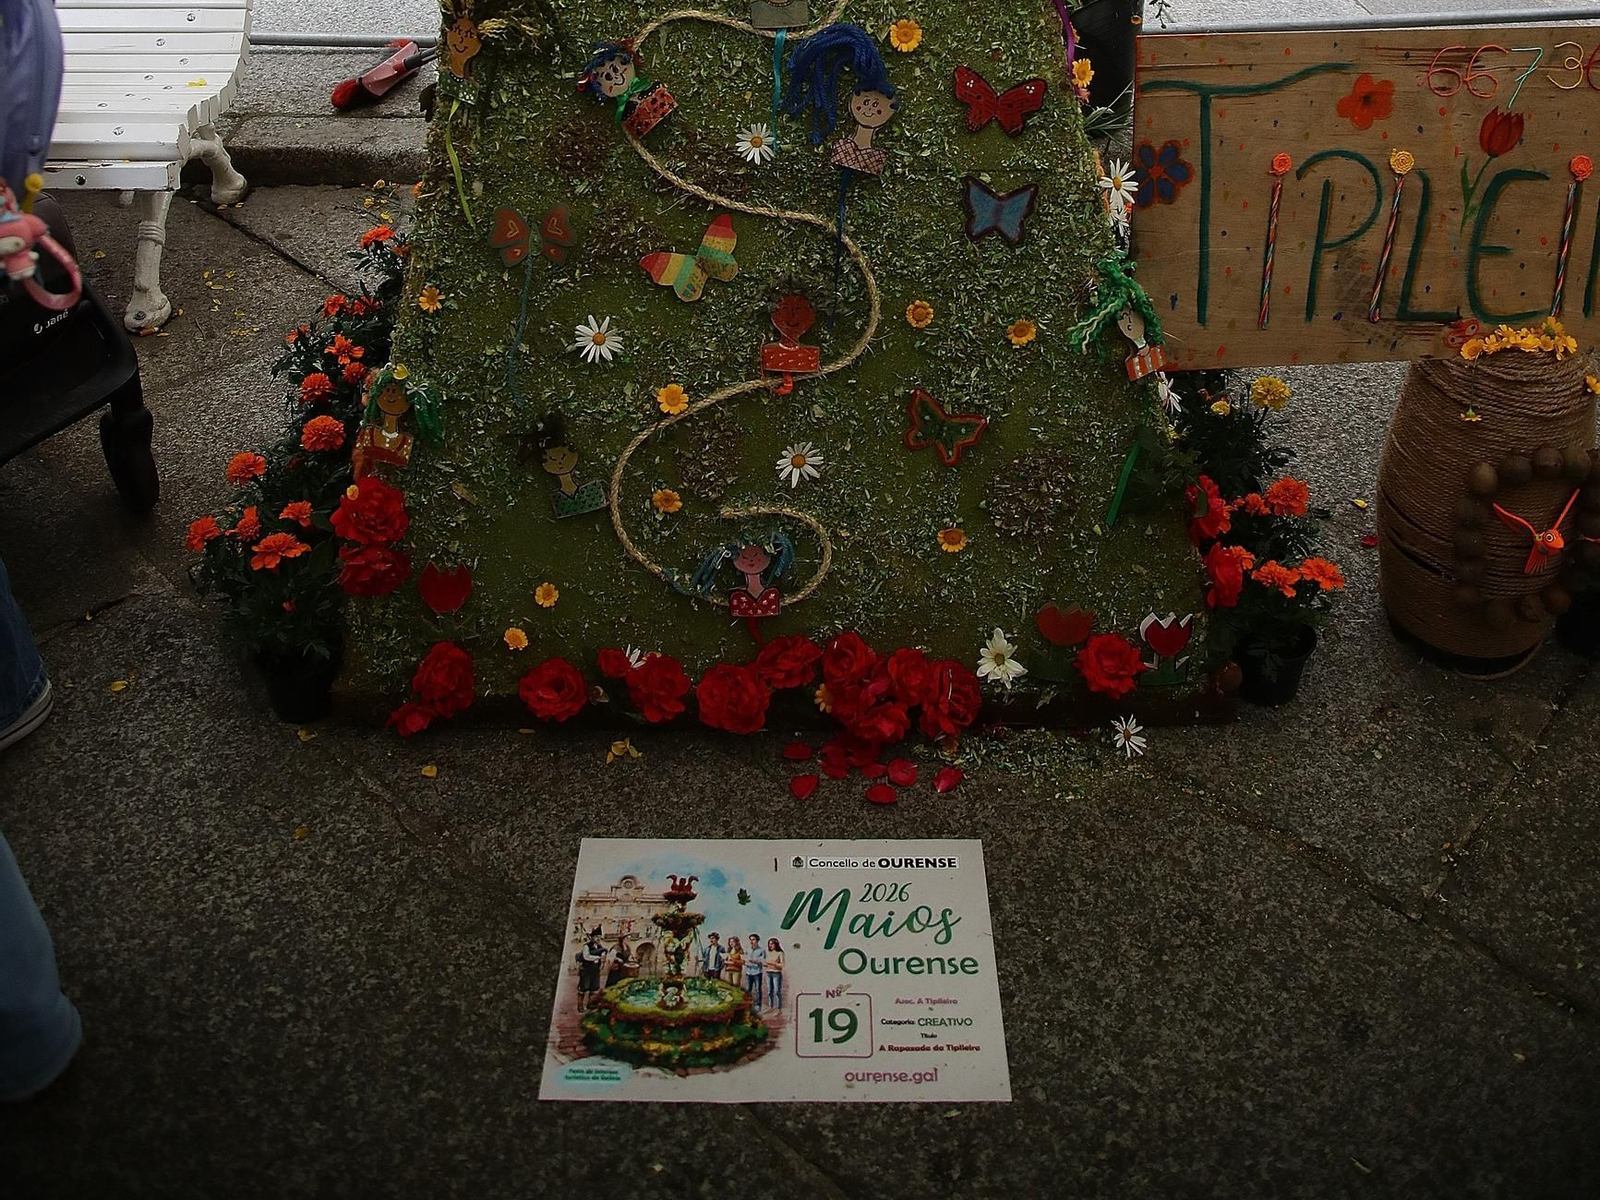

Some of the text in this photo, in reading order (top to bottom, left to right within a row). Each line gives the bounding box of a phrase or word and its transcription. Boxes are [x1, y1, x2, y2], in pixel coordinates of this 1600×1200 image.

[45, 308, 69, 328] jané
[809, 857, 958, 869] Concello de OURENSE
[859, 882, 912, 903] 2026
[780, 887, 962, 950] Maios
[837, 947, 980, 975] Ourense
[917, 997, 924, 1005] A
[808, 1007, 859, 1045] 19
[917, 1017, 973, 1027] CREATIVO
[879, 1044, 886, 1052] A
[845, 1066, 938, 1084] ourense.gal
